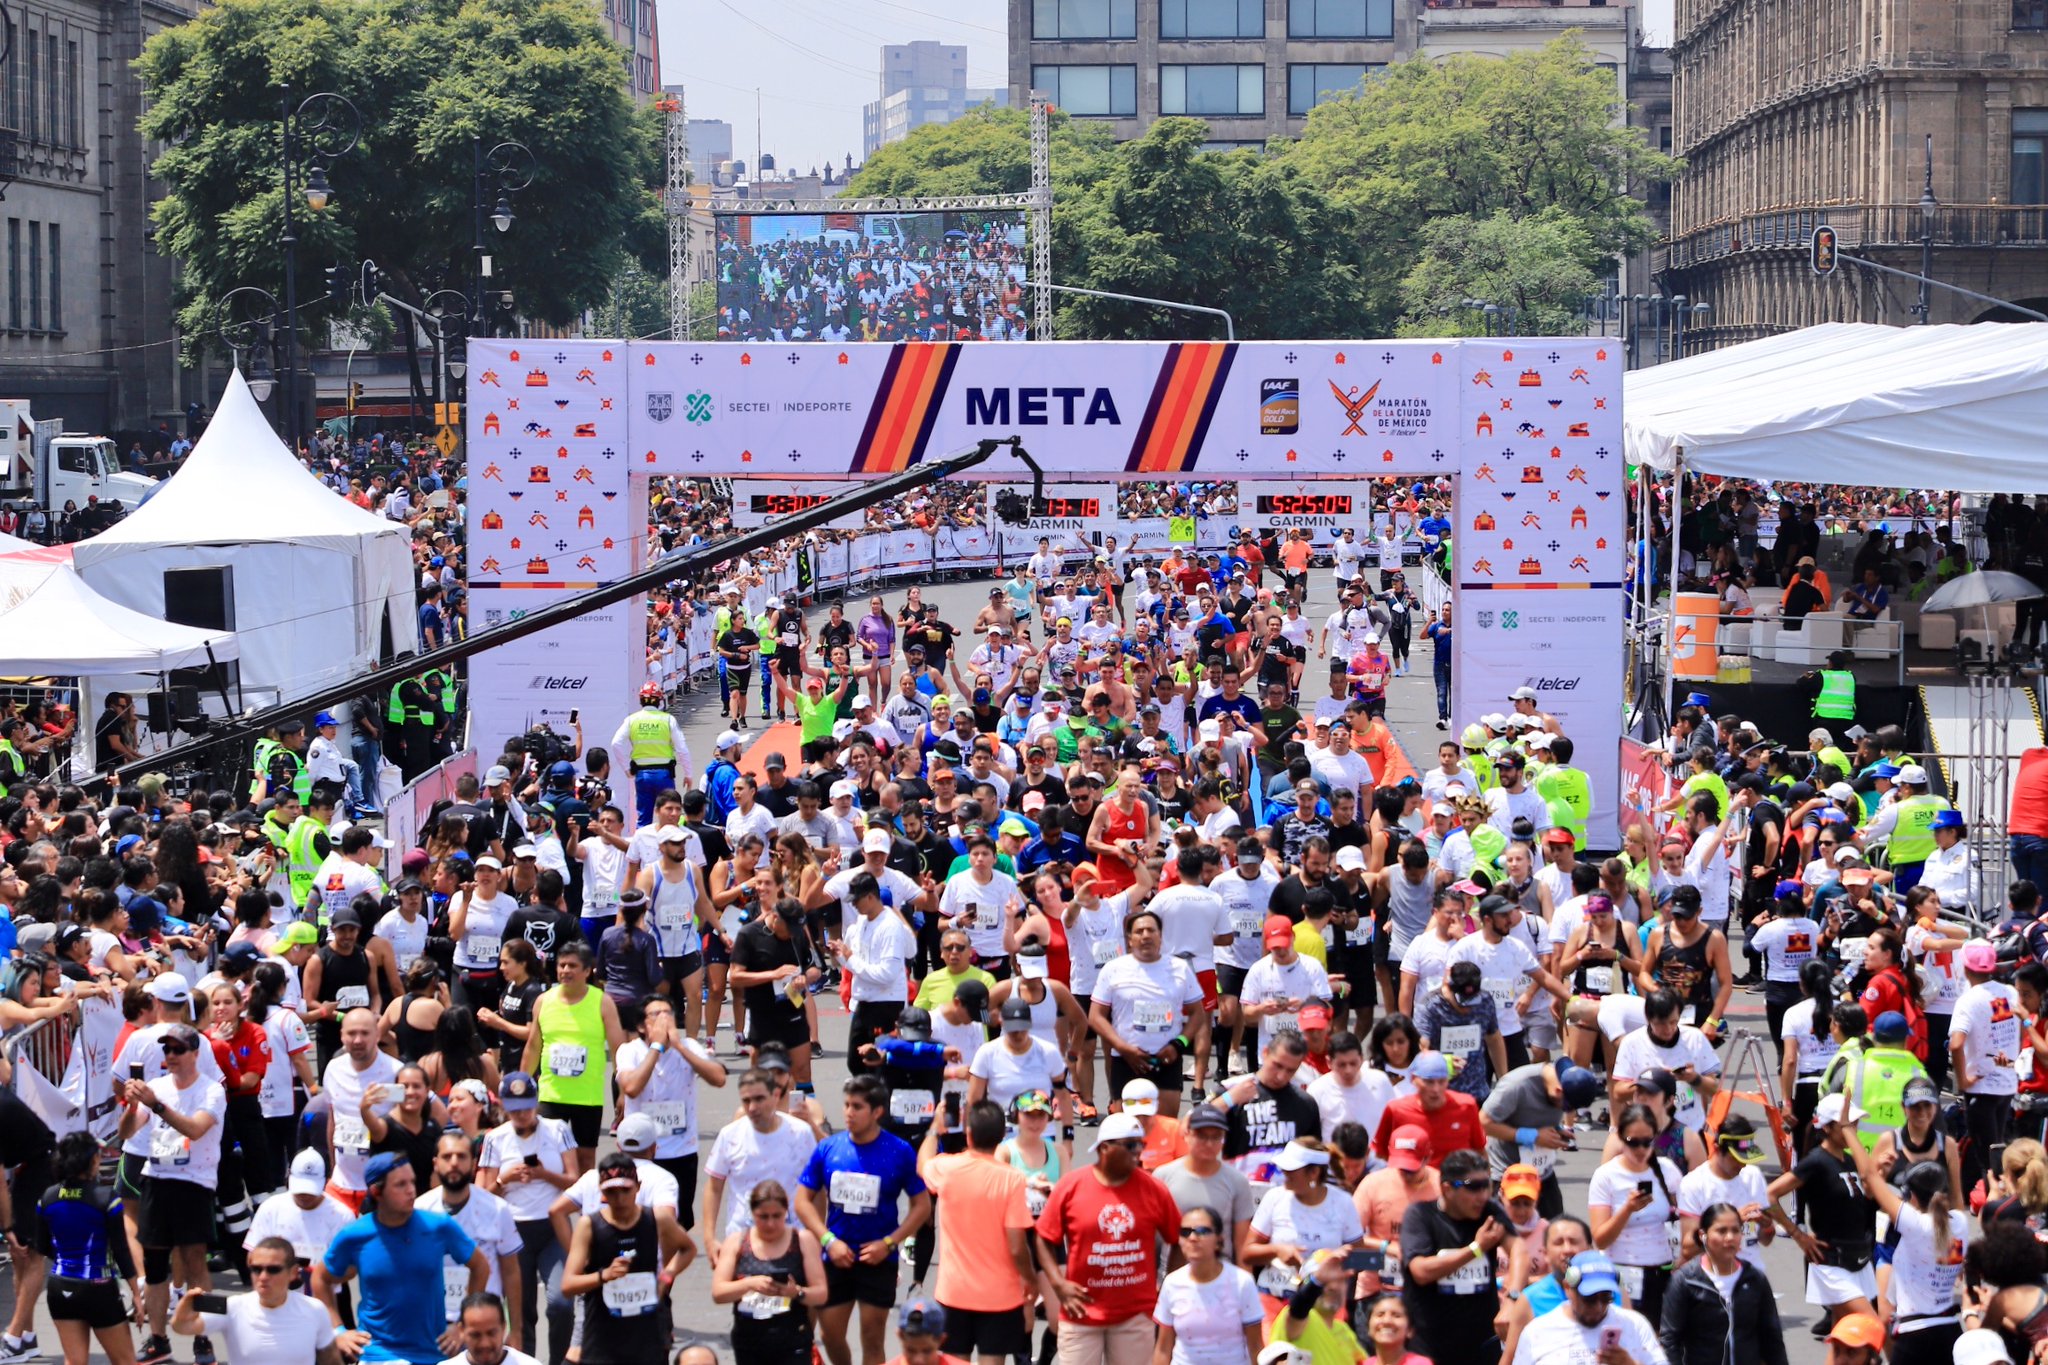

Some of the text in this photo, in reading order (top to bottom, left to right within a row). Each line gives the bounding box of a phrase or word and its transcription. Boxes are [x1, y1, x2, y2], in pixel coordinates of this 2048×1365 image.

[1263, 381, 1291, 390] IAAF
[729, 403, 770, 412] SECTEI
[783, 402, 852, 412] INDEPORTE
[966, 388, 1121, 425] META
[1378, 398, 1427, 407] MARATÓN
[1282, 408, 1297, 416] Race
[1373, 409, 1431, 417] DE LA CIUDAD
[1263, 415, 1285, 423] GOLD
[1378, 417, 1427, 427] DE MÉXICO
[1269, 515, 1336, 527] GARMIN
[544, 676, 588, 689] telcel
[1536, 677, 1580, 690] telcel
[639, 723, 660, 731] ERUM
[1243, 1100, 1278, 1124] THE
[1245, 1121, 1296, 1146] TEAM
[1091, 1240, 1141, 1255] Special
[1087, 1251, 1146, 1267] Olympics
[1103, 1265, 1134, 1276] México
[1087, 1277, 1113, 1287] Ciudad
[1113, 1277, 1124, 1287] de
